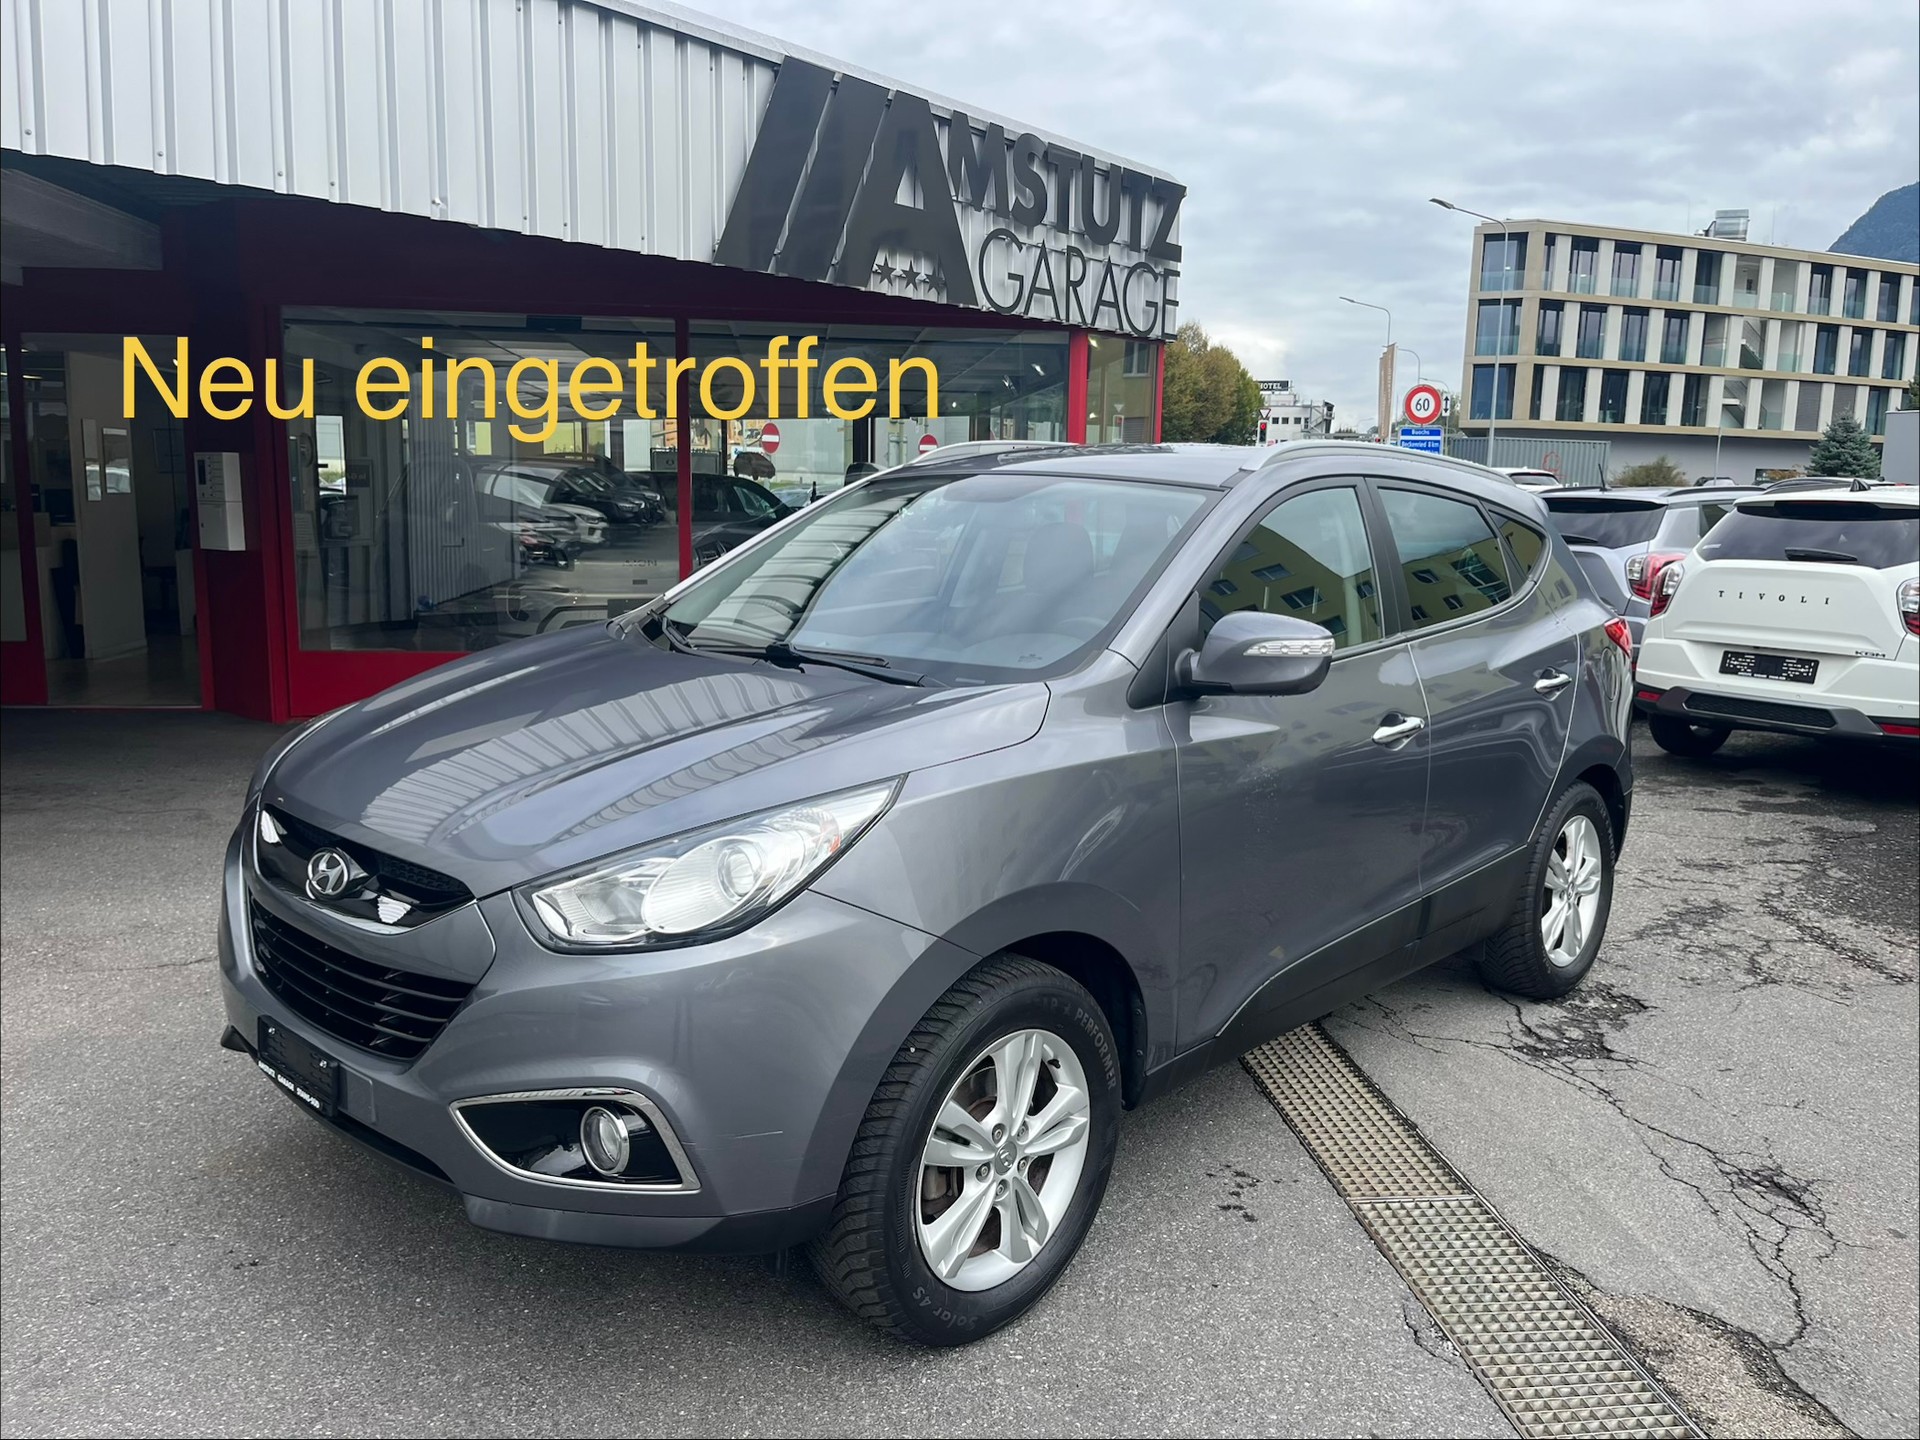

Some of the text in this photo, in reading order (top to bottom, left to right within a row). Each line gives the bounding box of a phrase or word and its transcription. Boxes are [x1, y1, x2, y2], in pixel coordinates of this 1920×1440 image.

[838, 89, 1187, 306] AMSTUTZ
[978, 228, 1181, 341] GARAGE
[1415, 398, 1430, 412] 60
[1718, 590, 1829, 605] TIVOLI
[1074, 1007, 1117, 1091] PERFORMER
[912, 1286, 979, 1331] Solar 4S
